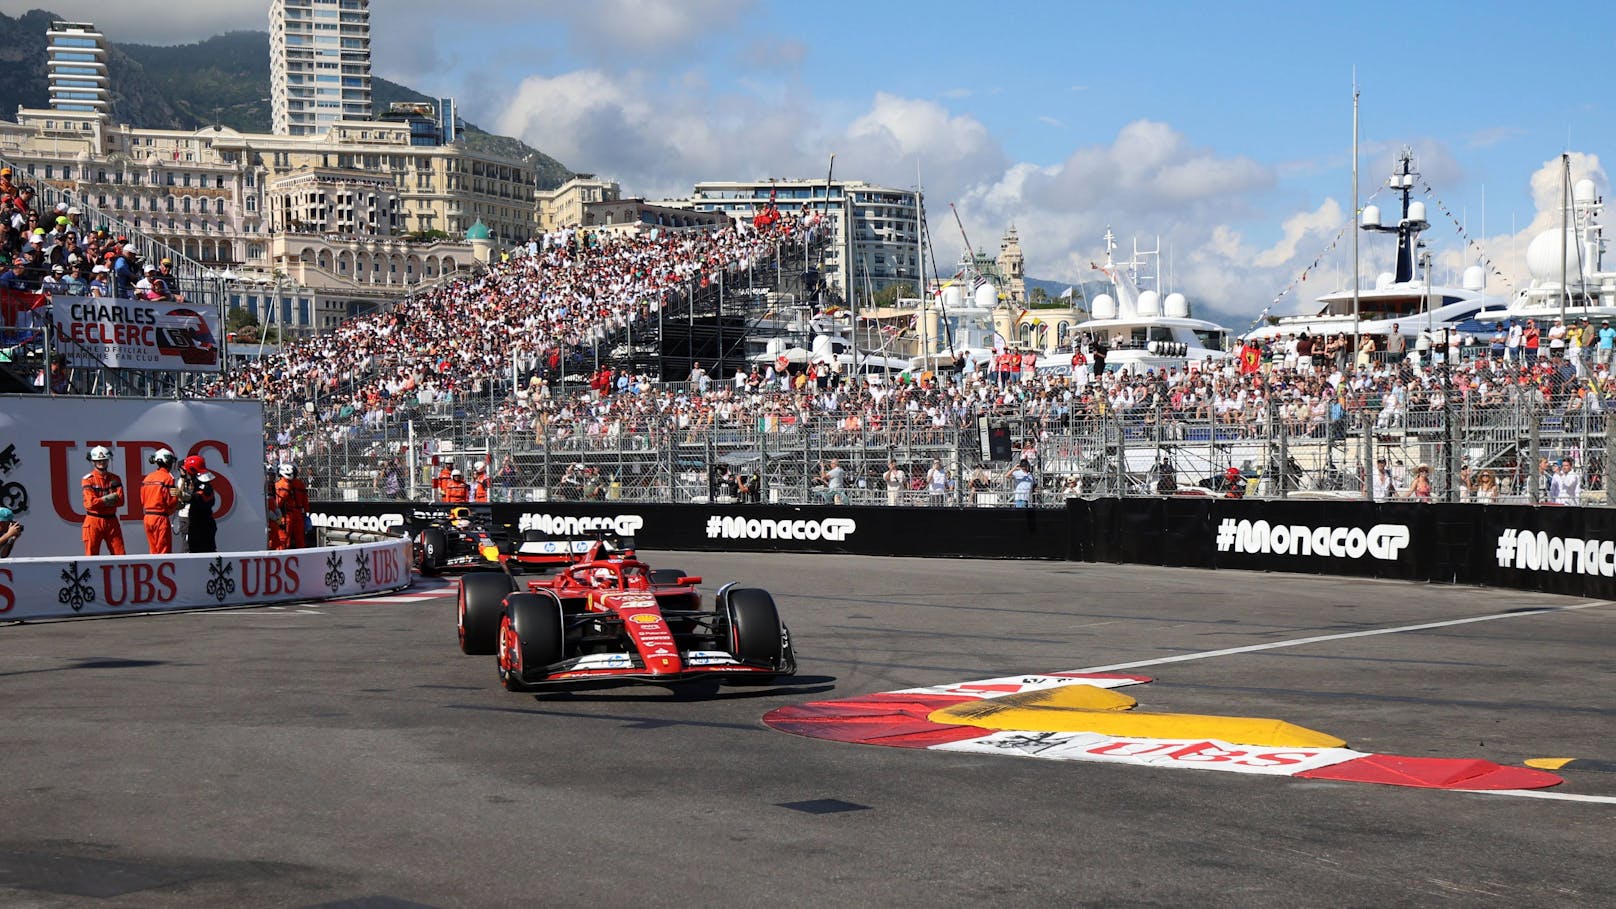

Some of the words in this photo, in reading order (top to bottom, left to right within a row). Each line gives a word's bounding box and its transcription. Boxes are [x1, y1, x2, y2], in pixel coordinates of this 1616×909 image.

[71, 304, 156, 325] CHARLES
[57, 322, 155, 347] LECLERC
[136, 354, 160, 362] CLUB
[40, 439, 235, 523] UBS
[518, 513, 643, 536] #MonacoGP
[706, 515, 856, 541] #MonacoGP
[1216, 518, 1410, 560] #MonacoGP
[372, 548, 399, 585] UBS
[1496, 528, 1616, 577] #Monac
[100, 562, 177, 606] UBS
[240, 556, 299, 597] UBS
[1086, 740, 1319, 767] UBS
